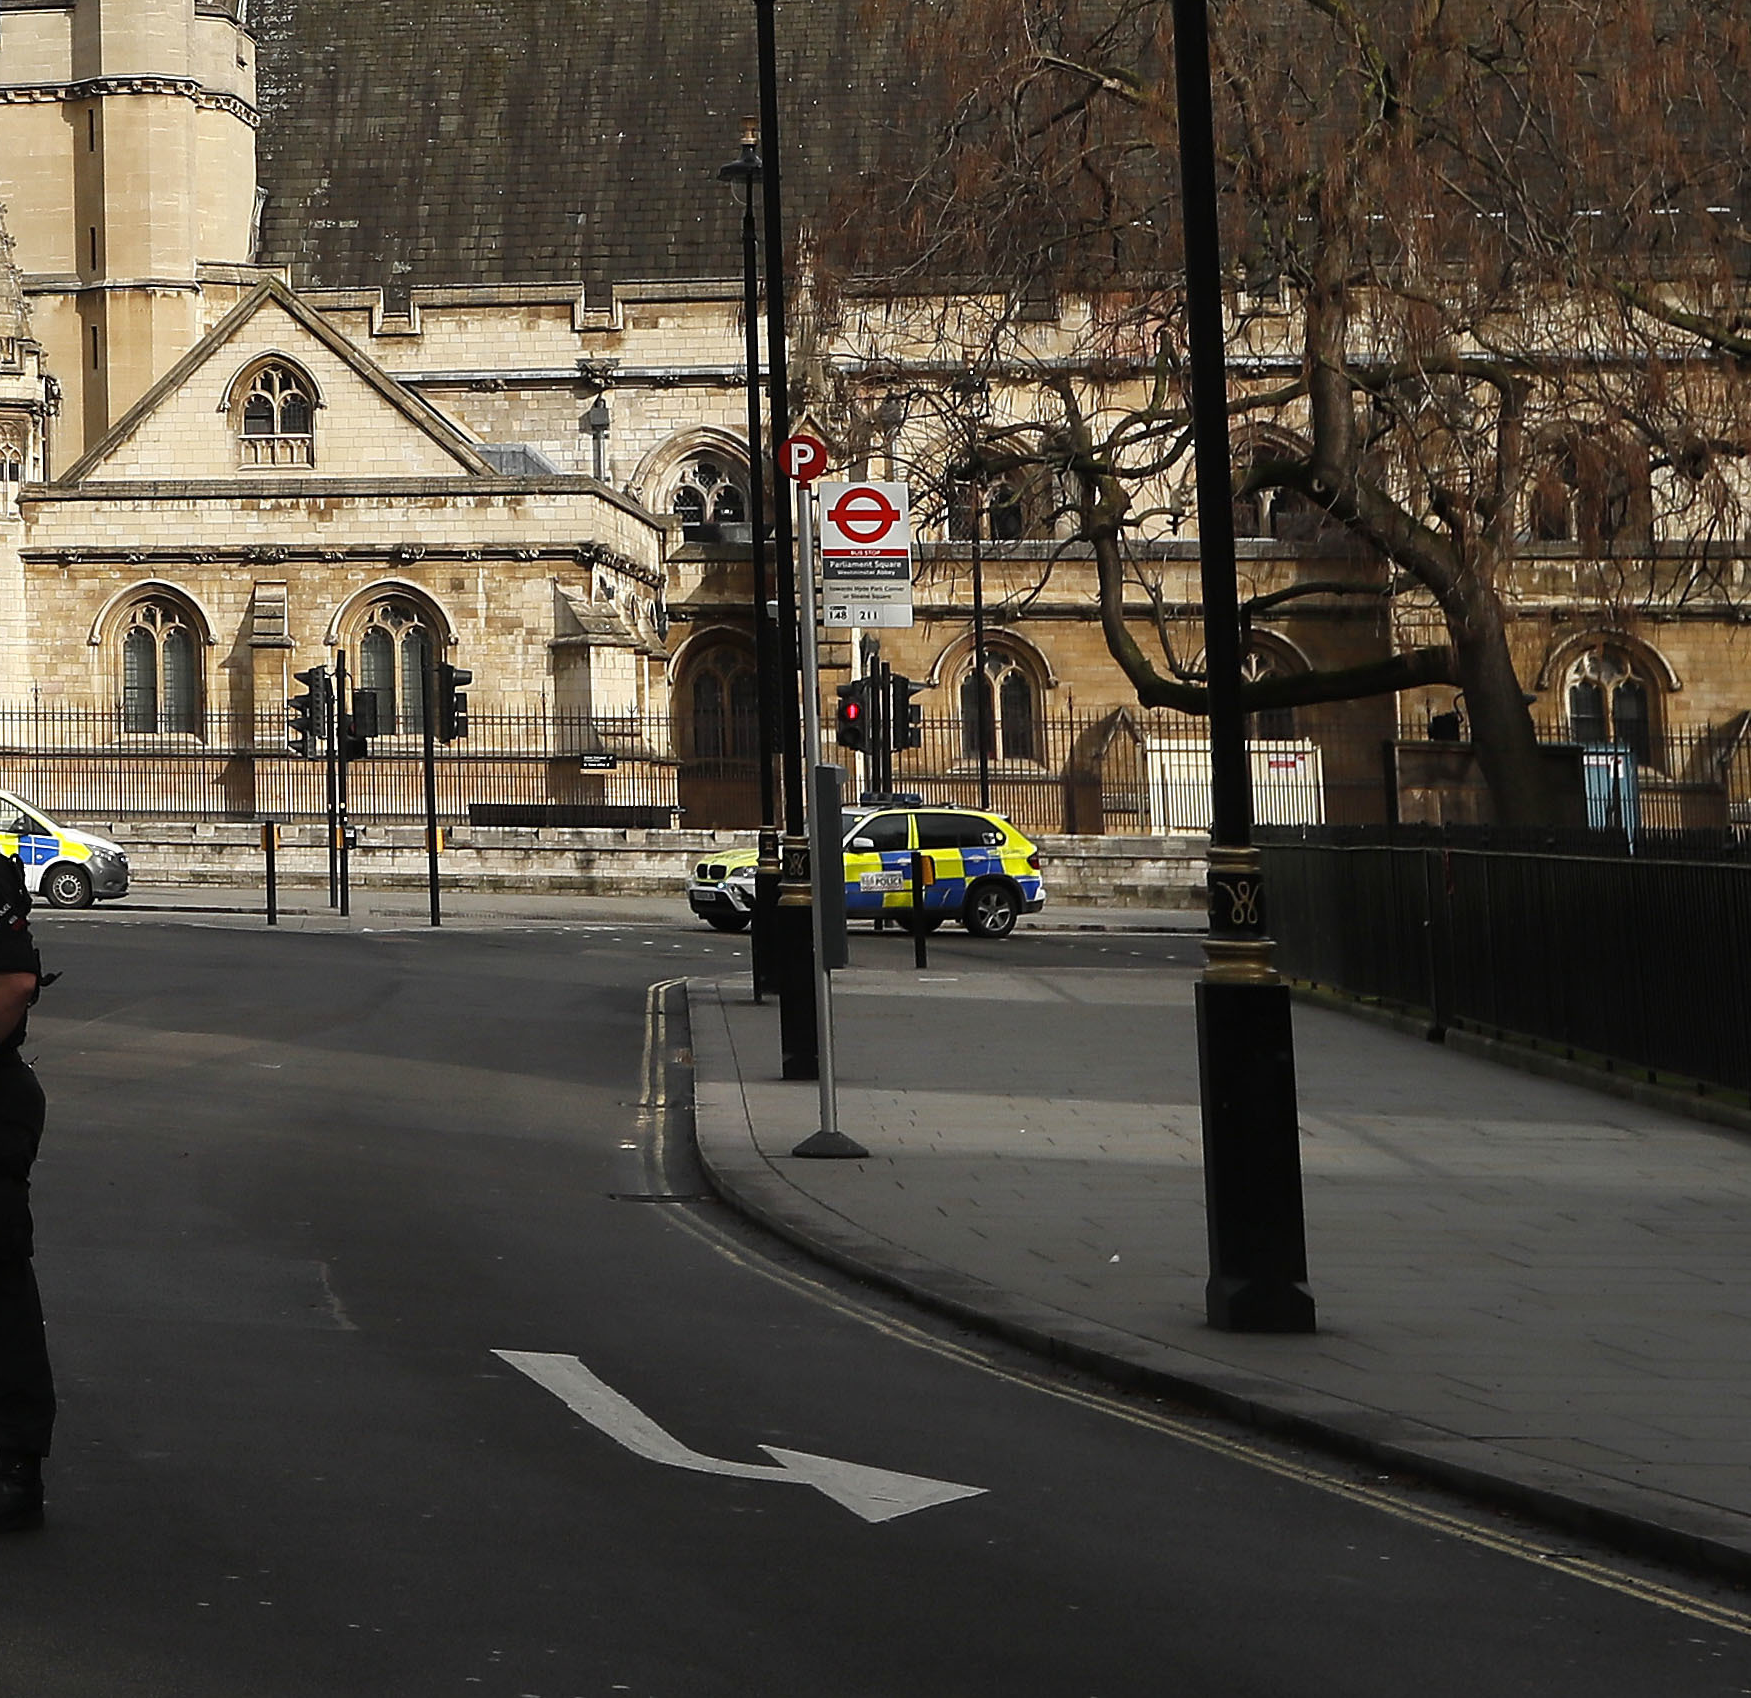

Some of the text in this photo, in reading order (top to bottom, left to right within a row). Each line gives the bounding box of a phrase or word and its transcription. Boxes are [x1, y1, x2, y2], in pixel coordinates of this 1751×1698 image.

[791, 443, 814, 475] P
[829, 561, 902, 569] Parliament Square
[829, 611, 878, 620] 148 211
